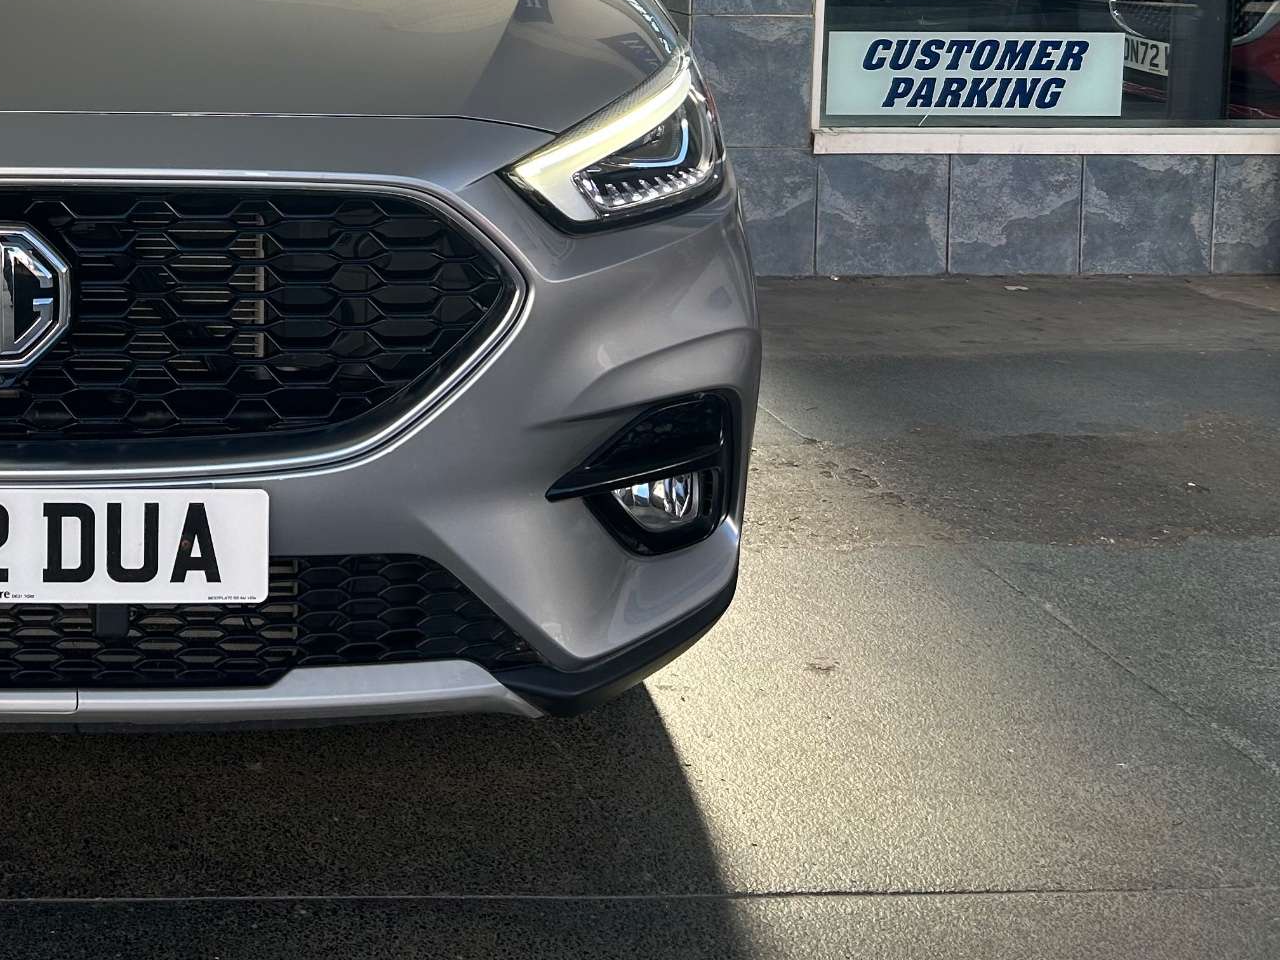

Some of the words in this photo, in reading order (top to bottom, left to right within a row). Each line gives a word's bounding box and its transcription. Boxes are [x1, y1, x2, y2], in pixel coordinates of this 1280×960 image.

[862, 38, 1089, 72] CUSTOMER
[882, 76, 1067, 110] PARKING
[42, 502, 223, 584] DUA
